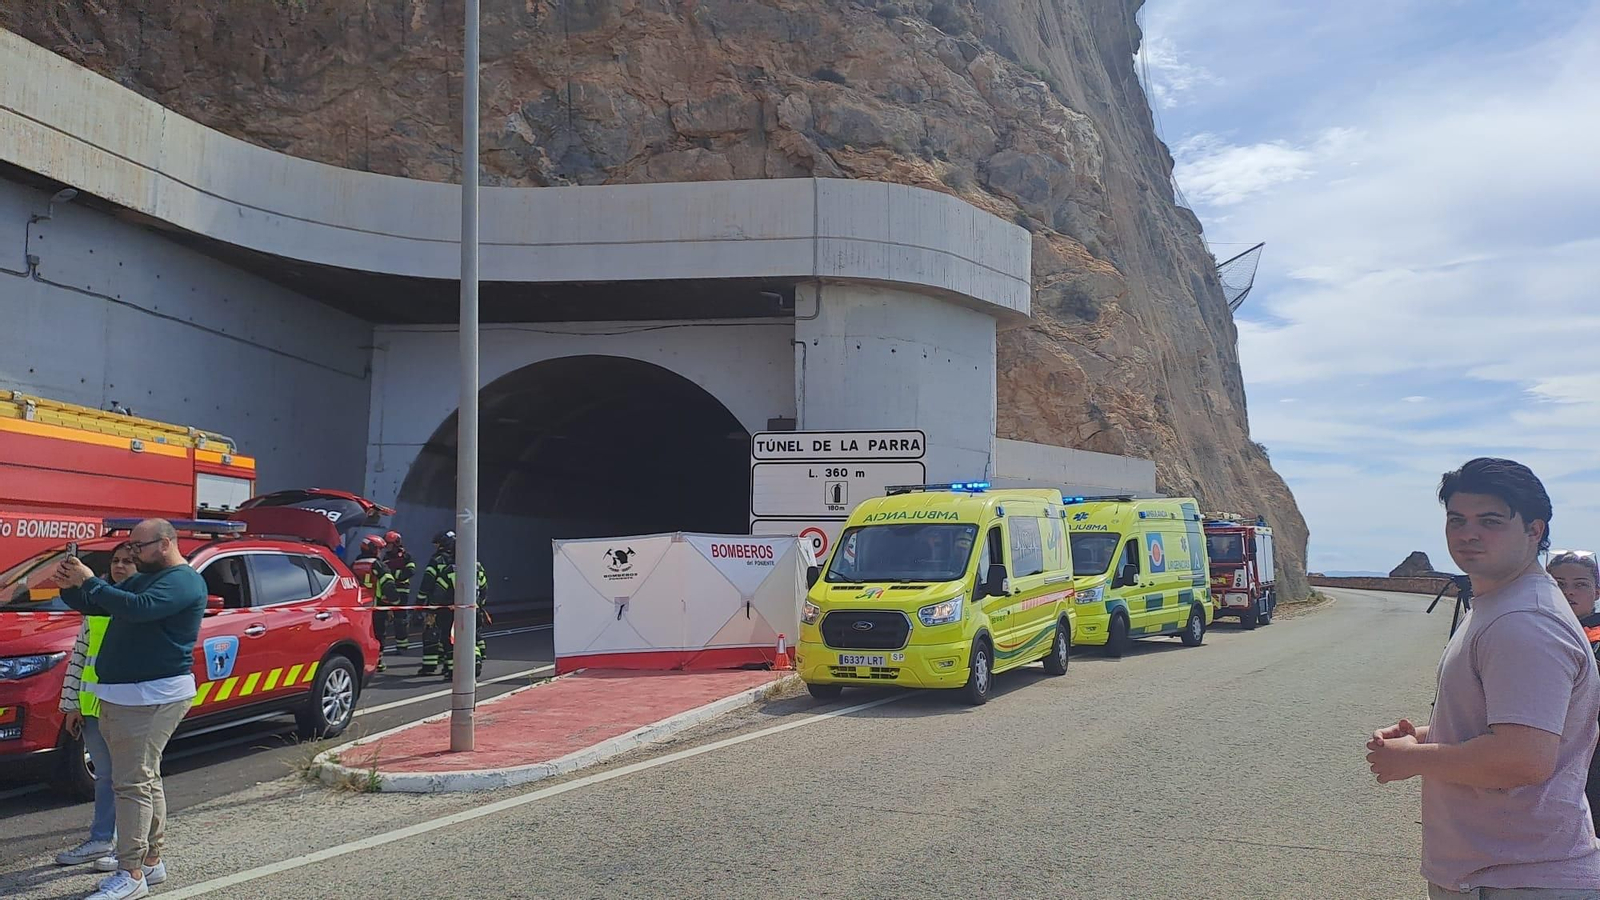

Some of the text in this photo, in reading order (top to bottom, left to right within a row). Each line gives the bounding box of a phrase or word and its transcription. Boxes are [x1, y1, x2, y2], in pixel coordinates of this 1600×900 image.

[757, 438, 921, 452] TÚNEL DE LA PARRA
[808, 468, 865, 478] L. 360 m
[16, 519, 96, 539] BOMBEROS
[711, 544, 774, 559] BOMBEROS
[844, 655, 884, 665] 6337 LRT
[892, 653, 904, 661] SP
